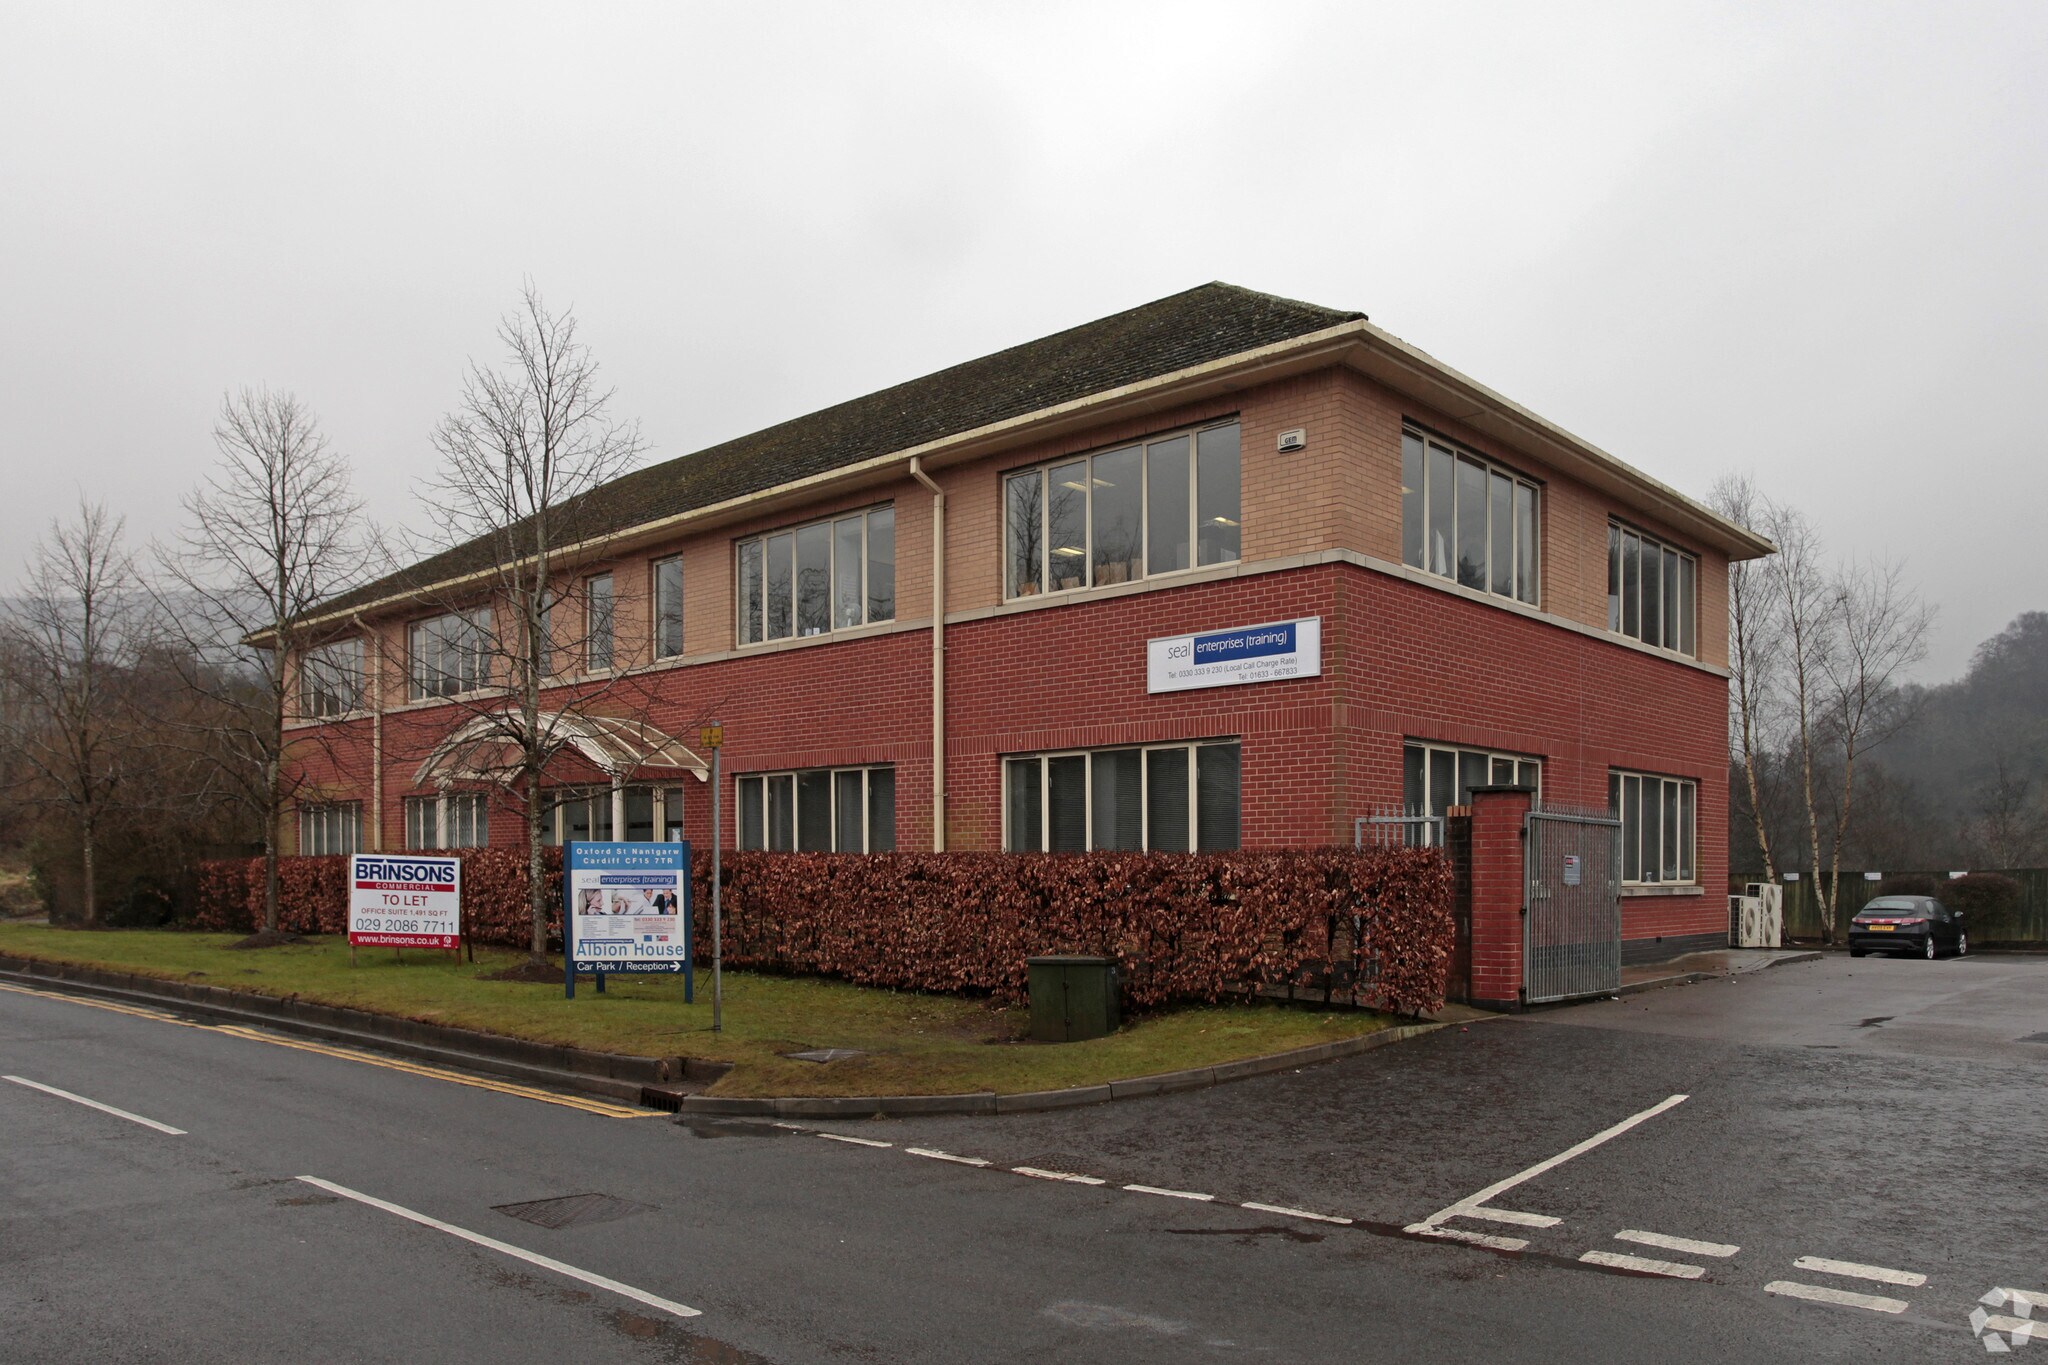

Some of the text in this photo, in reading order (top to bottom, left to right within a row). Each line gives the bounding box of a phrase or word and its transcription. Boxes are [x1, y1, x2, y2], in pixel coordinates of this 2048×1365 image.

[1168, 630, 1288, 660] seal enterprises (training)
[1168, 671, 1177, 680] Tel:
[1178, 670, 1194, 678] 0330
[1194, 668, 1206, 676] 333
[1211, 666, 1223, 674] 230
[1224, 662, 1242, 674] (Local
[1243, 661, 1255, 670] Call
[1256, 658, 1279, 670] Charge
[1280, 656, 1298, 666] Rate)
[1238, 673, 1248, 681] Tel:
[1250, 671, 1269, 680] 01633
[1274, 667, 1298, 677] 667833
[632, 848, 679, 856] Nantgarw
[356, 864, 455, 882] BRINSONS
[376, 882, 435, 891] COMMERCIAL
[601, 876, 640, 884] enterprises
[642, 876, 674, 884] (training)
[382, 894, 428, 906] TO LET
[356, 918, 454, 933] 029 2086 7711
[357, 935, 439, 945] www.brinsons.co.uk
[576, 942, 684, 956] Albion House
[577, 962, 669, 972] Car Park / Reception
